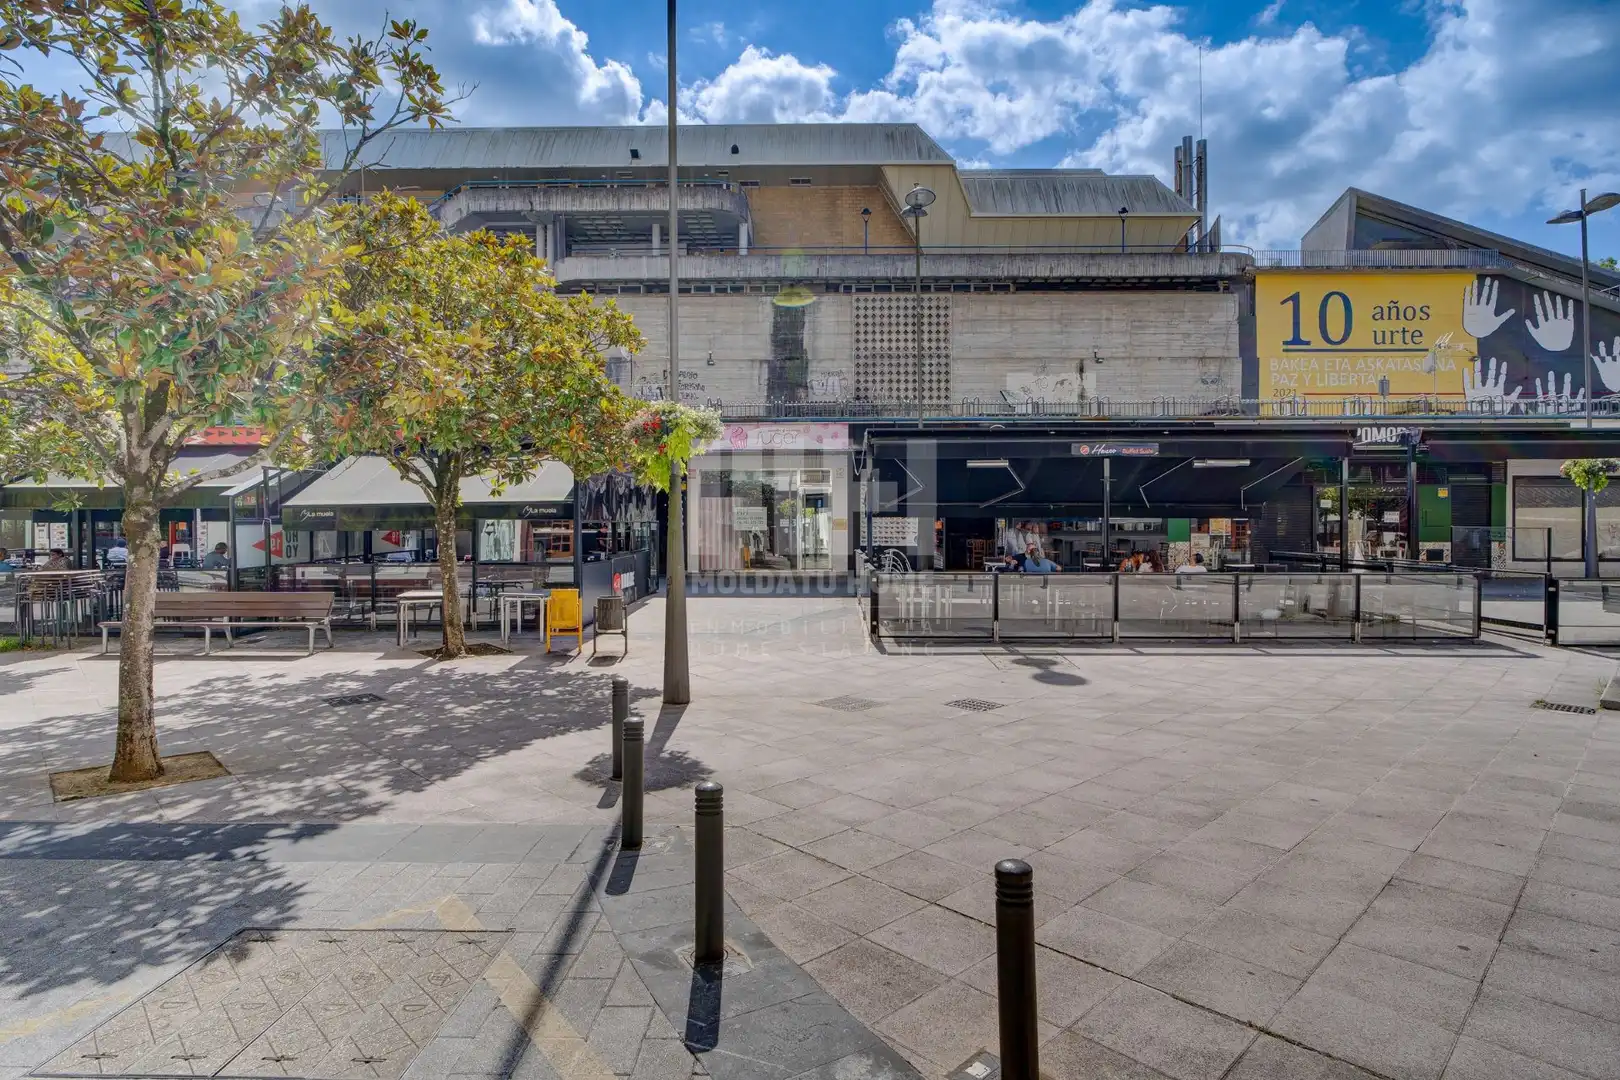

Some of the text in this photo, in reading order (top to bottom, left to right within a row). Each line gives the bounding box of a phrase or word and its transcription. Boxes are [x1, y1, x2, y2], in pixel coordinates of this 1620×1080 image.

[1280, 290, 1430, 346] 10 años
[1372, 326, 1424, 345] urte
[1269, 358, 1319, 371] BAKEA
[1324, 358, 1349, 371] ETA
[1271, 373, 1298, 386] PAZ
[1302, 373, 1313, 386] Y
[1272, 388, 1297, 398] 2021
